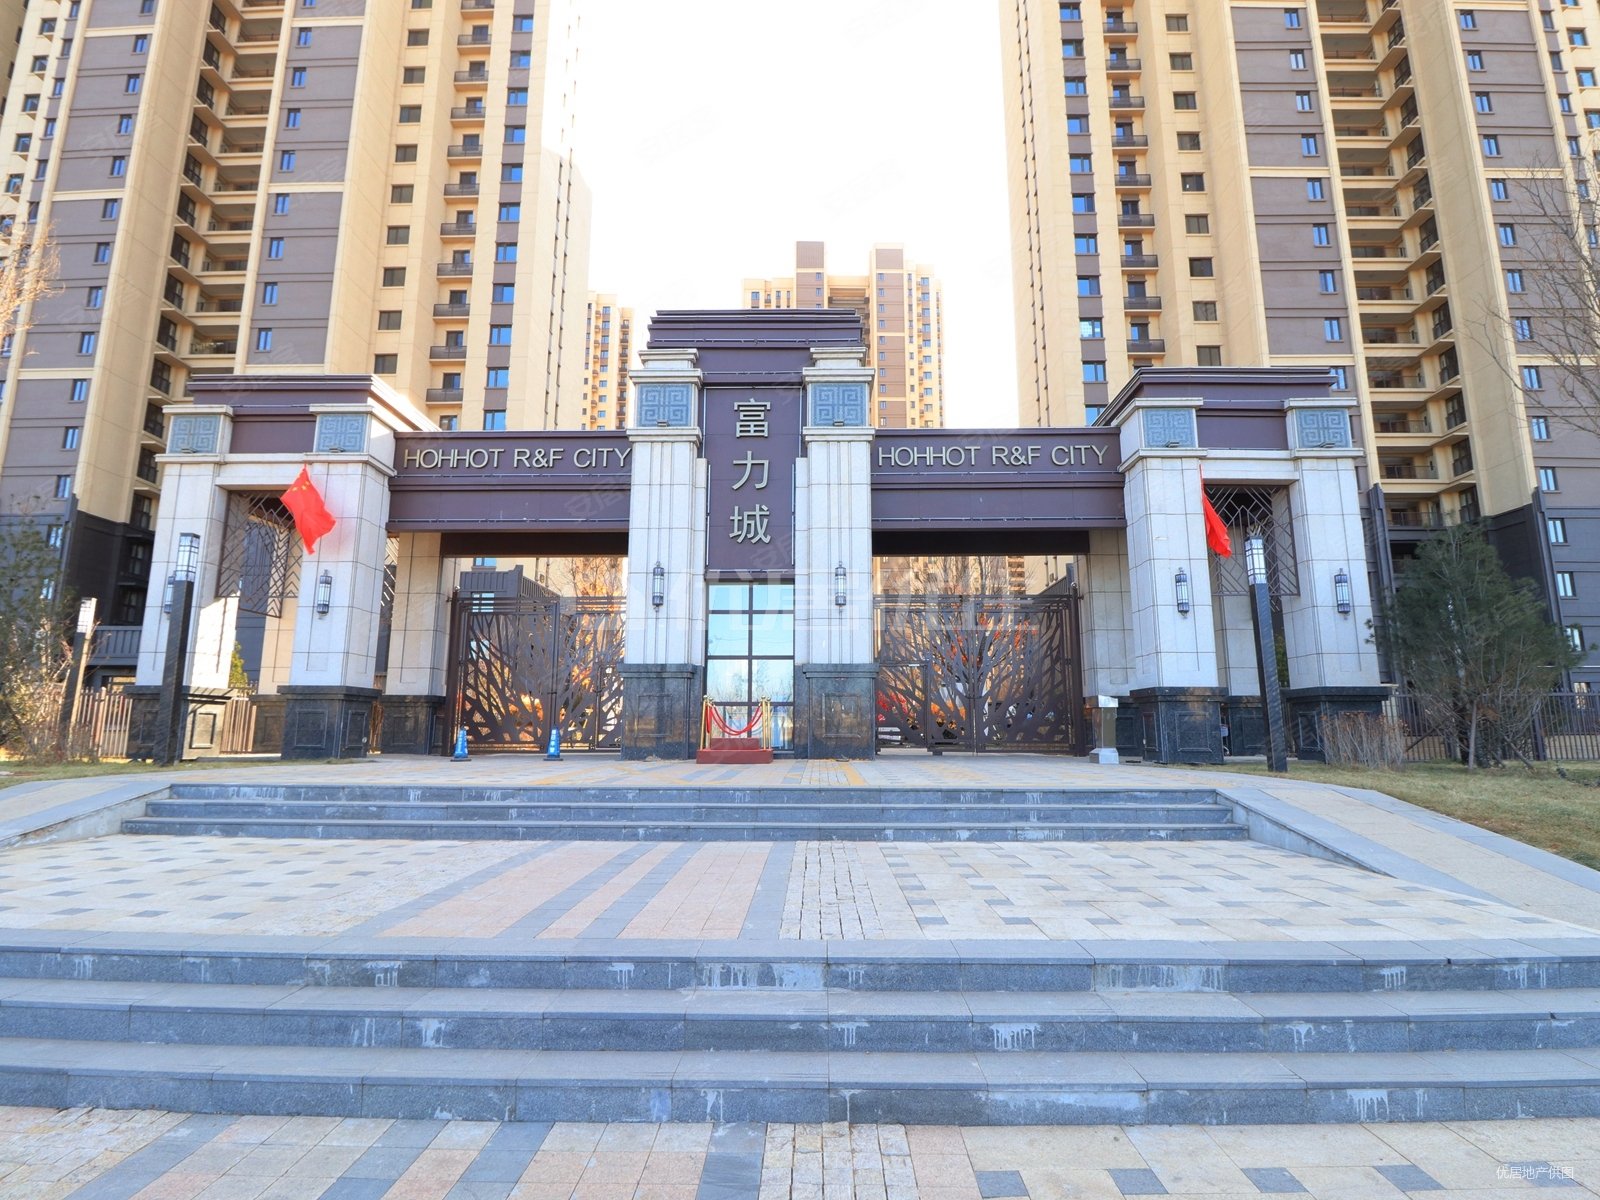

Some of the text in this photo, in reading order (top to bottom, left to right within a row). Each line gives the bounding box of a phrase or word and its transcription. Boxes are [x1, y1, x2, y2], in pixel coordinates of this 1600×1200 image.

[403, 447, 631, 468] HOHHOT R&F CITY
[878, 444, 1108, 467] HOHHOT R&F CITY
[730, 397, 772, 544] 富力城
